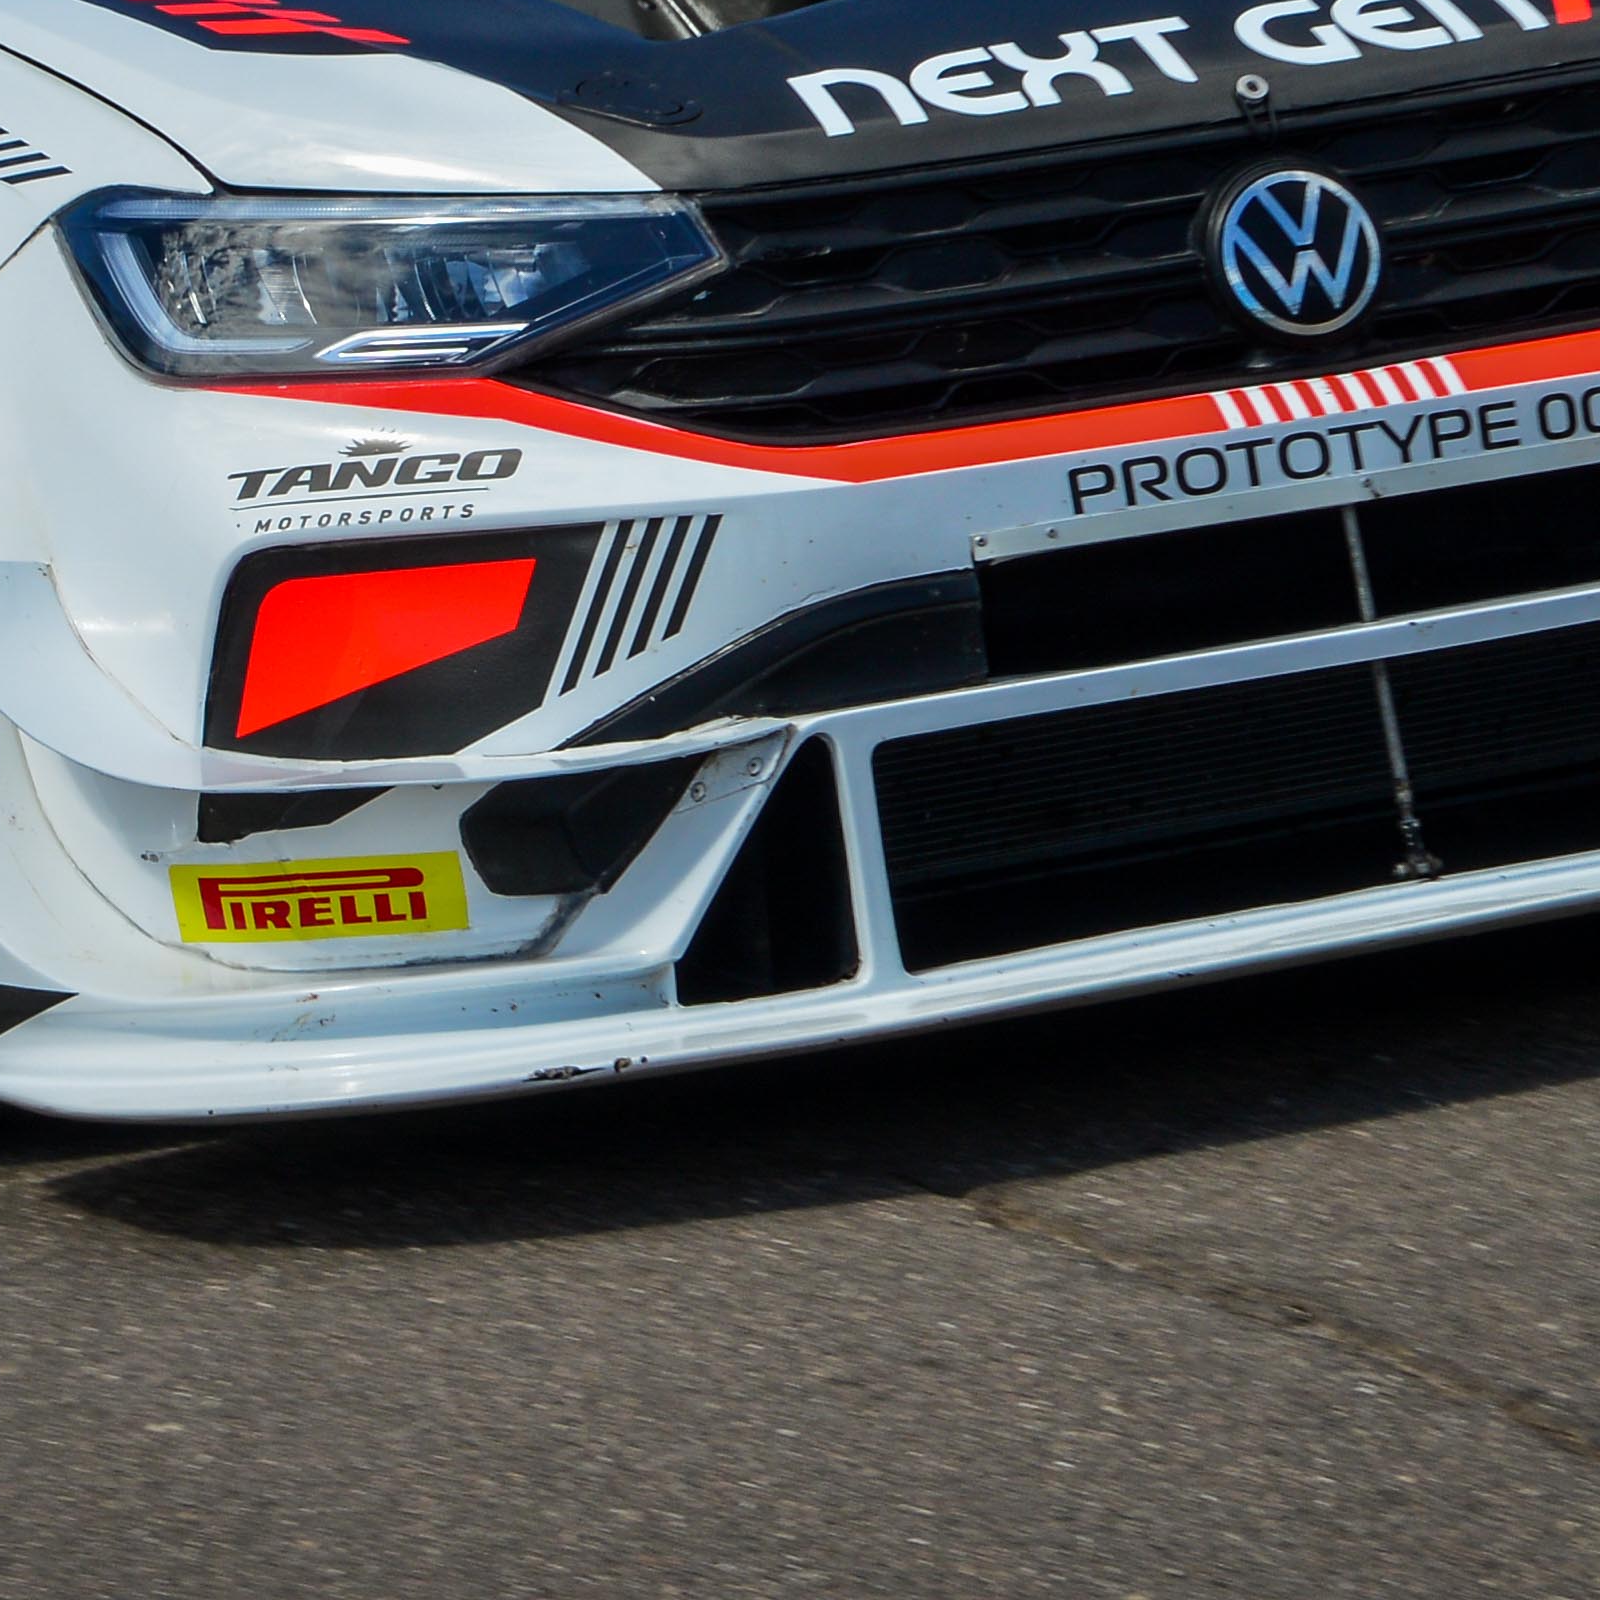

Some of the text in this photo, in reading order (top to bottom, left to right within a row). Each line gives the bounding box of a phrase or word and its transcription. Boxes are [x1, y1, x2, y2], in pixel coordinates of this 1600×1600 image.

[787, 16, 1198, 137] NEXT
[227, 448, 524, 501] TANGO
[1066, 400, 1521, 515] PROTOTYPE
[253, 503, 477, 534] MOTORSPORTS
[197, 866, 429, 932] PIRELLI
